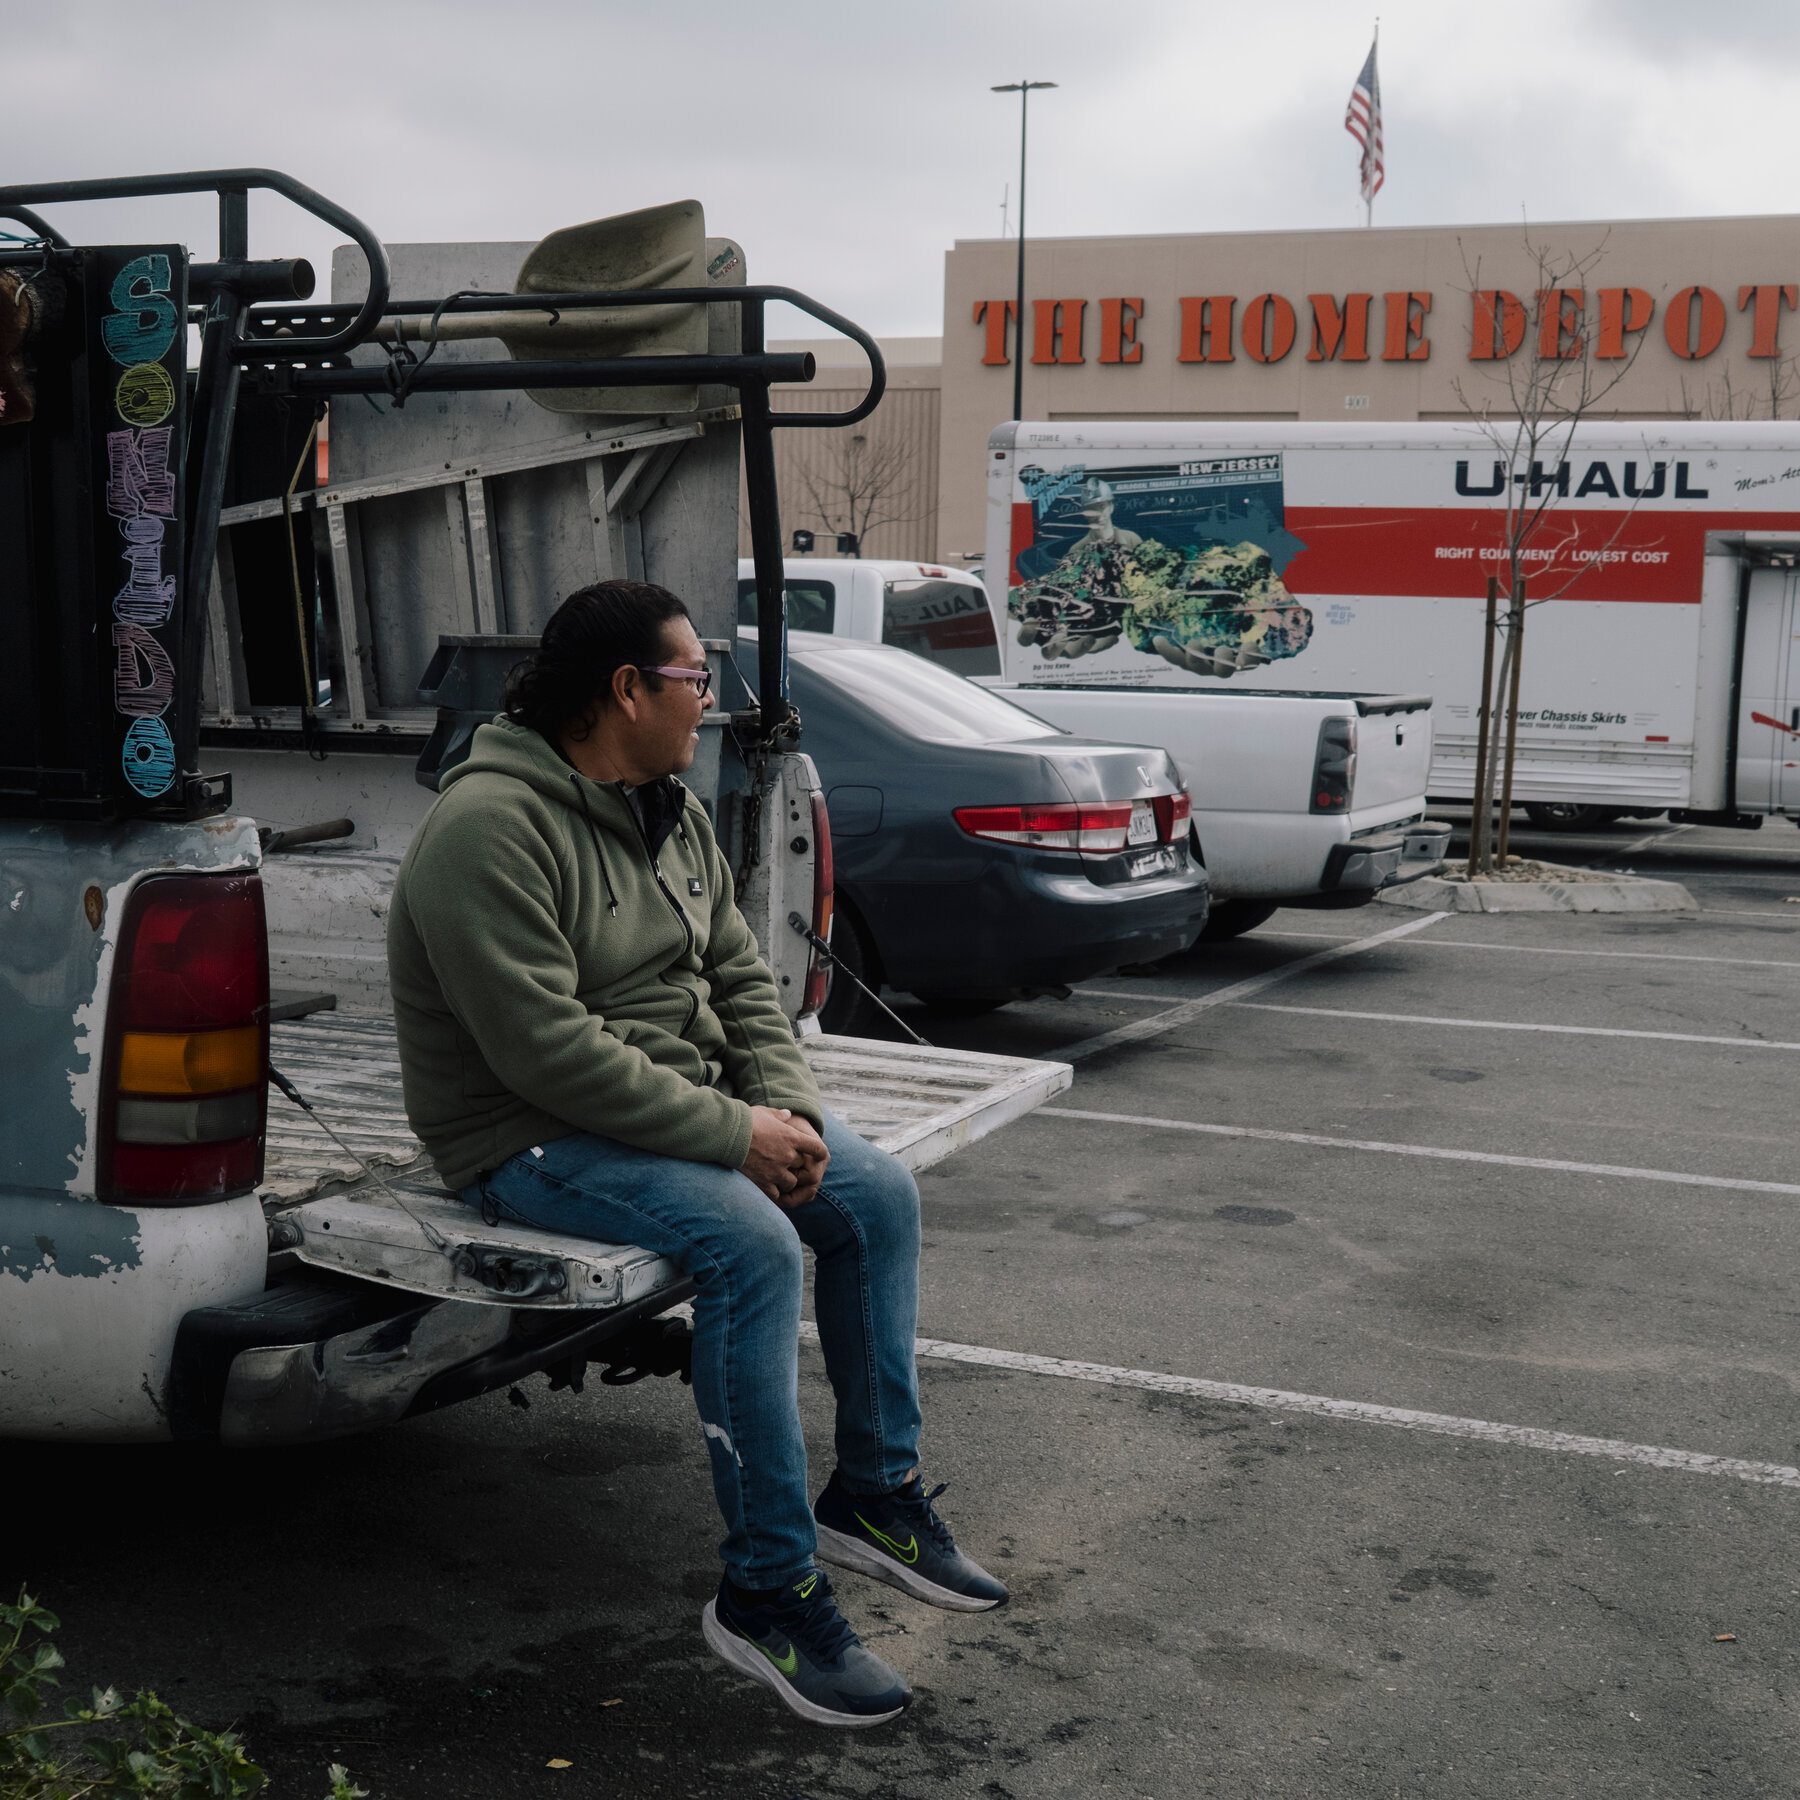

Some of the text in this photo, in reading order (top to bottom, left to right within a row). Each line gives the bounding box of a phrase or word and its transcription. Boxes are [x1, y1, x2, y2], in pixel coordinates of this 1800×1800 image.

[973, 285, 1799, 366] THE HOME DEPOT
[1179, 456, 1278, 476] NEW JERSEY
[1455, 460, 1709, 499] U-HAUL
[1435, 547, 1474, 559] RIGHT
[1479, 548, 1557, 561] EQUIMENT
[1572, 550, 1628, 562] LOWEST
[1632, 551, 1669, 563] COST
[1541, 709, 1588, 722] Chassis
[1590, 712, 1627, 724] Skirts
